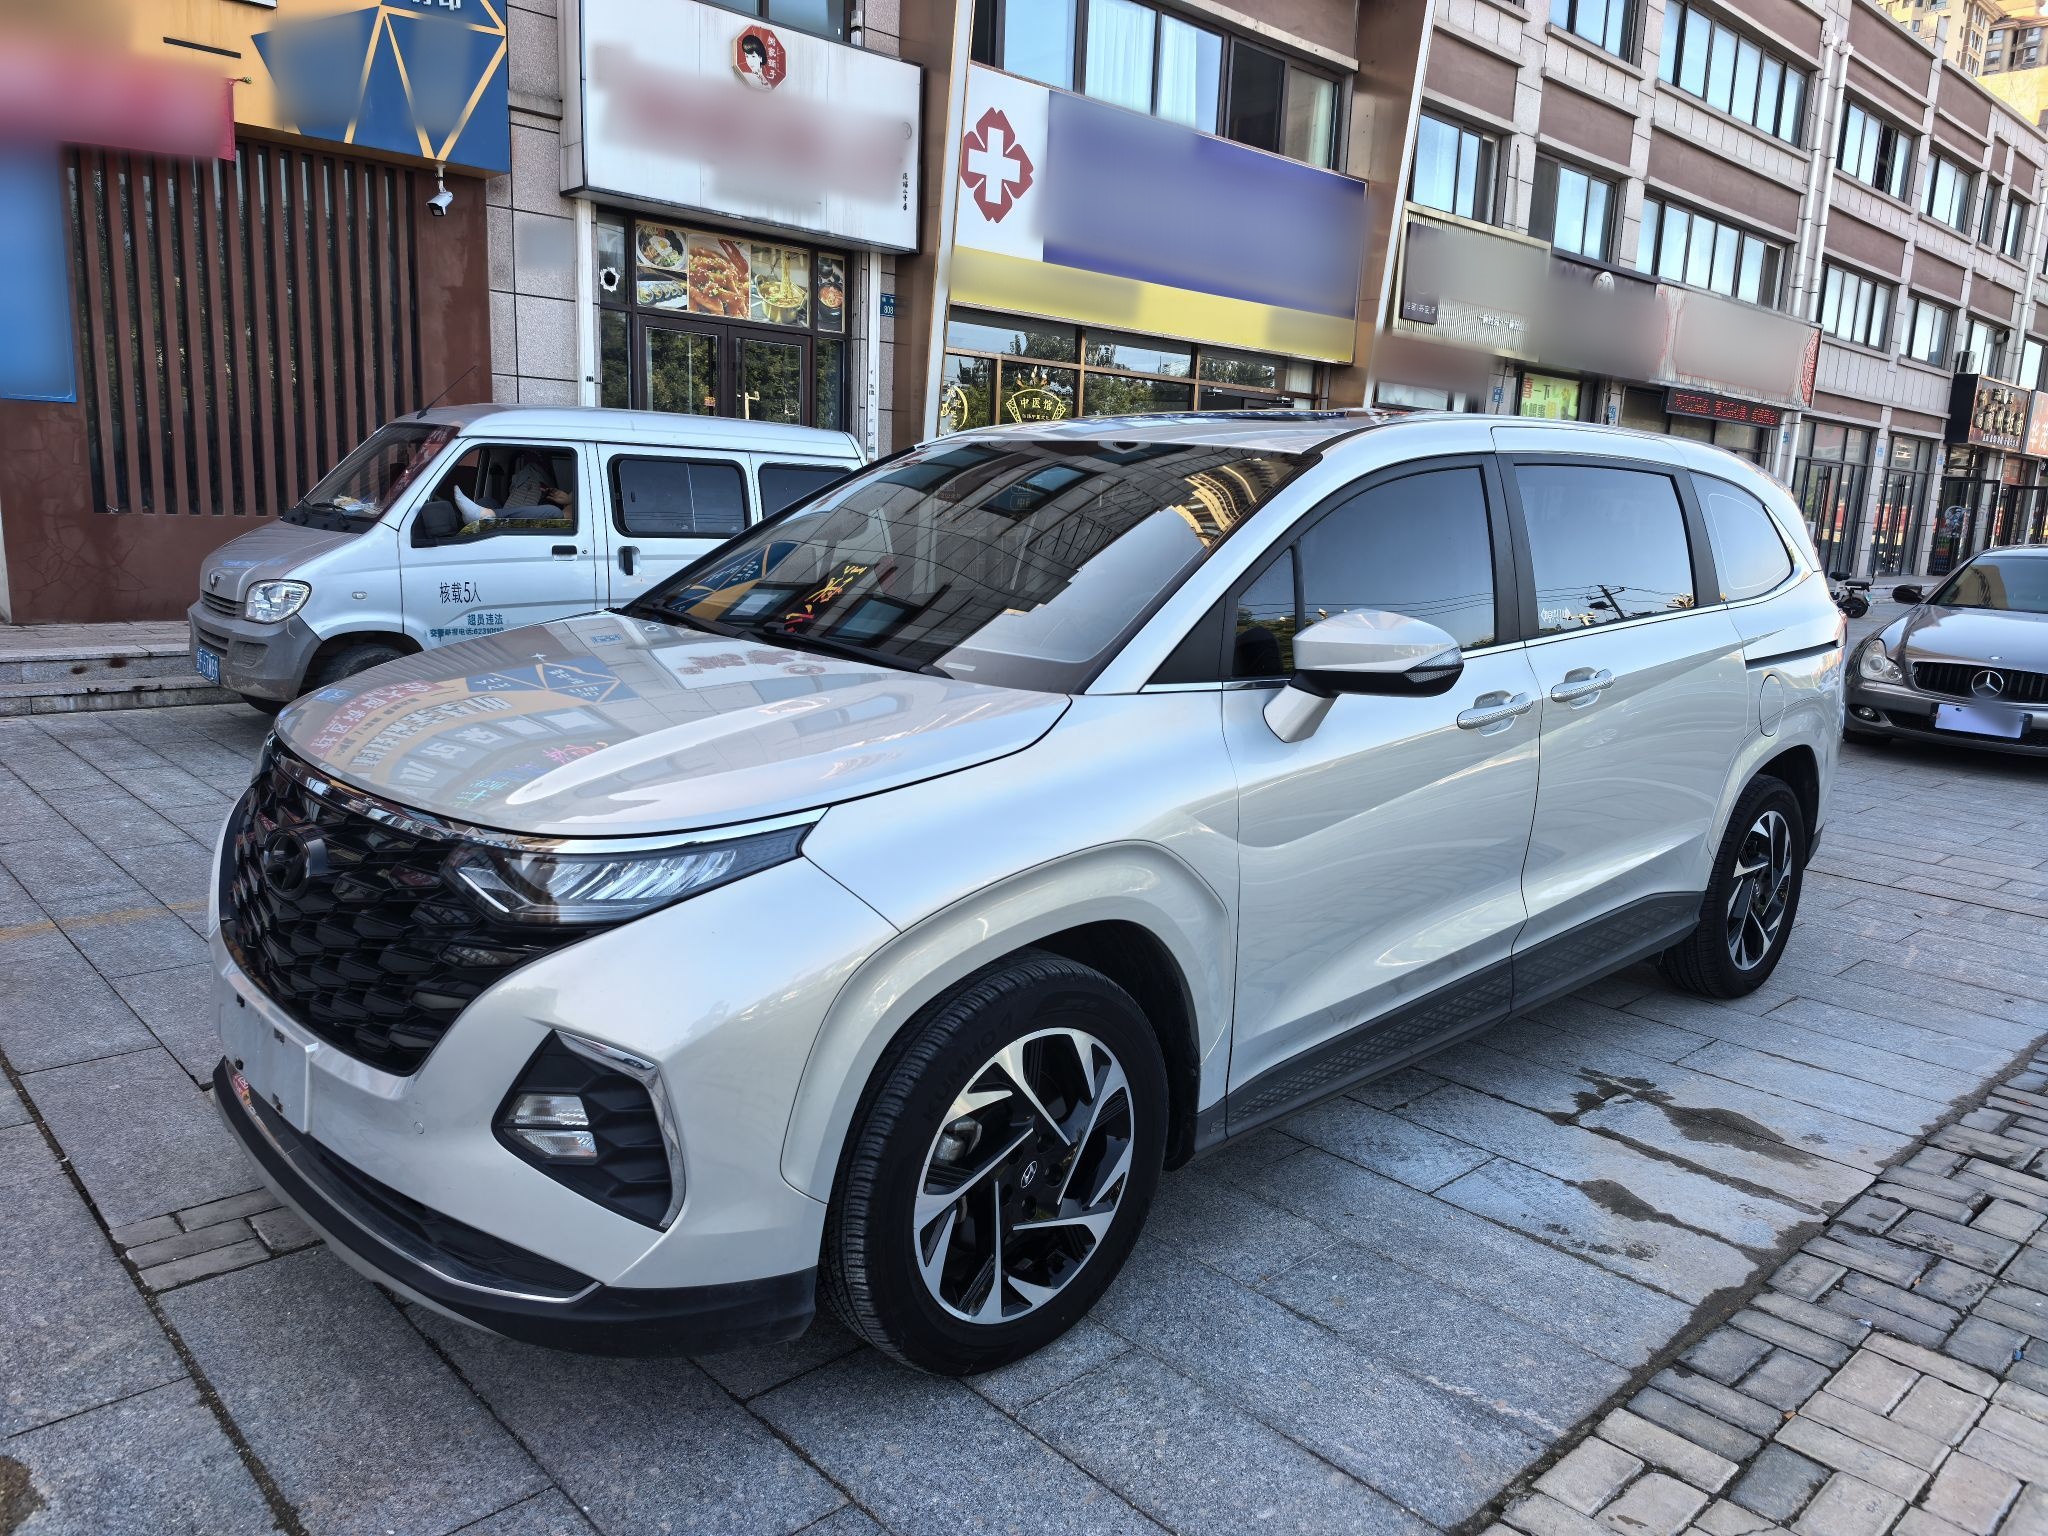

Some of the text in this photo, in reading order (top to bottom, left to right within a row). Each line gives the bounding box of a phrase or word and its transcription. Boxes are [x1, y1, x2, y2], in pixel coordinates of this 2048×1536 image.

[1020, 397, 1053, 411] 中医馆
[439, 581, 481, 604] 核载5人
[467, 613, 504, 626] 超员违法
